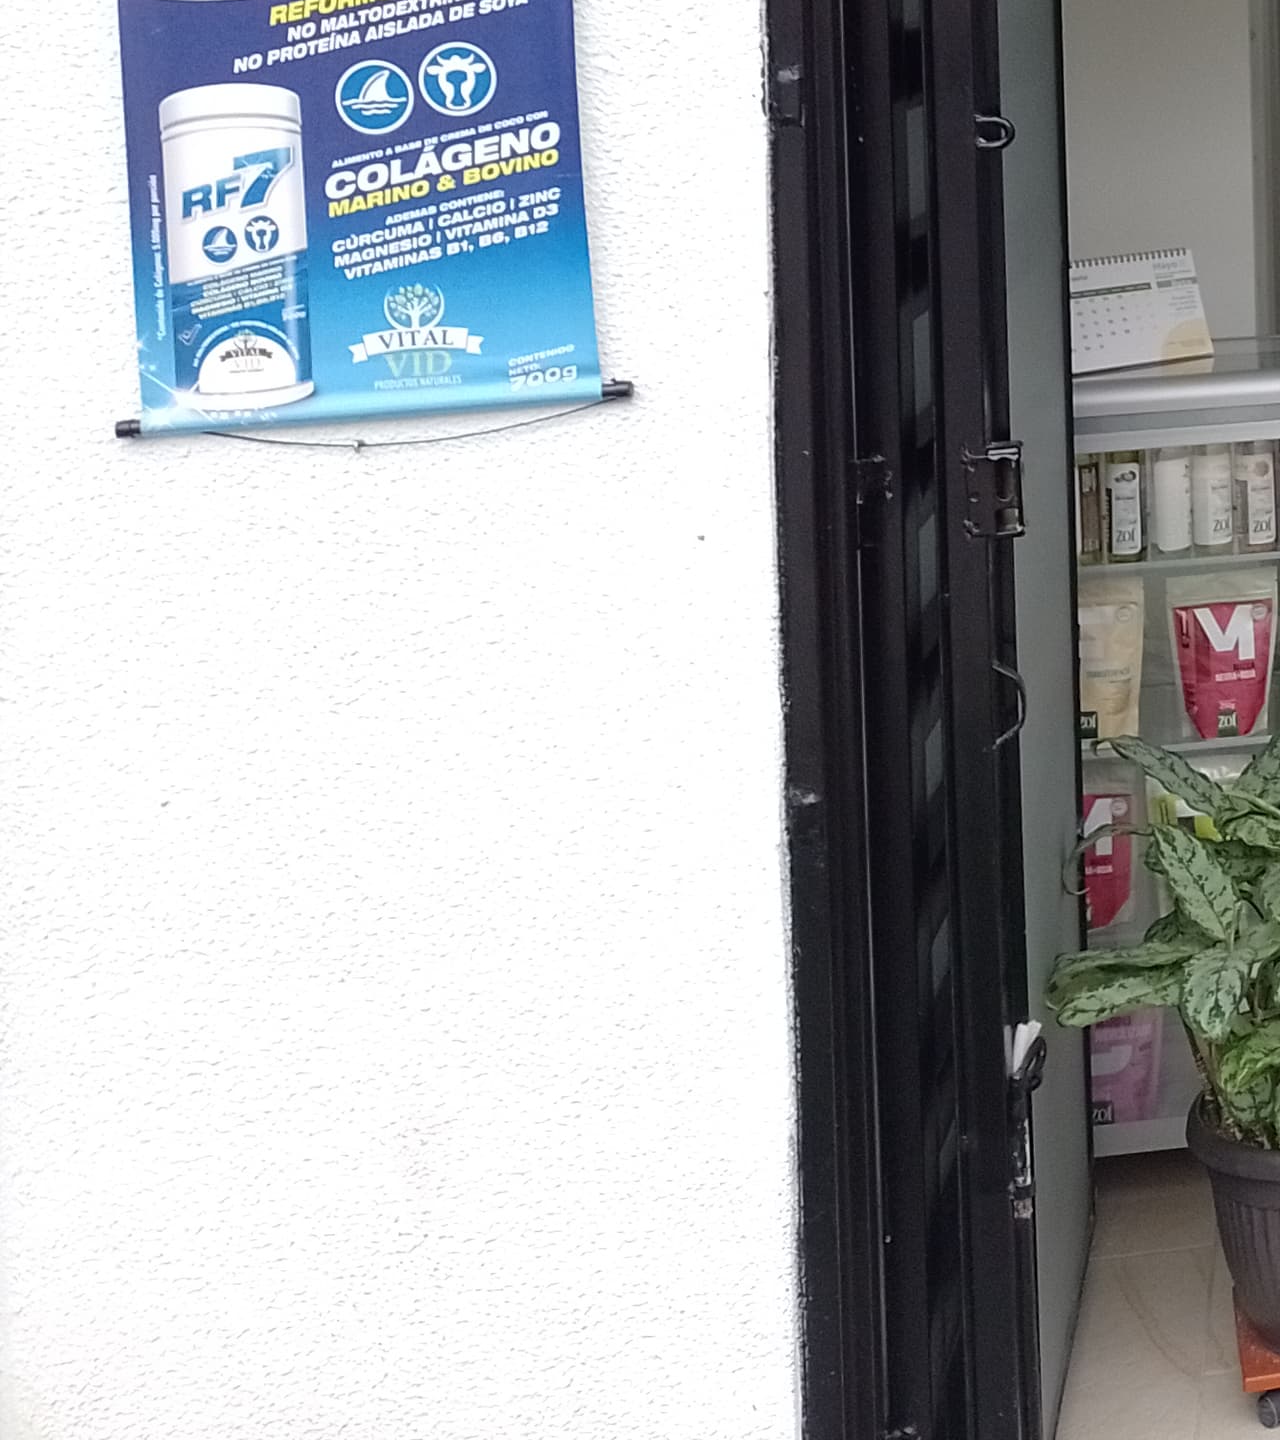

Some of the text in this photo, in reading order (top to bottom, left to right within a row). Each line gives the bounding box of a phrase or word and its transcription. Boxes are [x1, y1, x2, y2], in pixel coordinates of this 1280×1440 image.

[233, 53, 262, 74] NO
[267, 32, 360, 66] PROTEÍNA
[365, 7, 444, 42] AISLADA
[449, 1, 475, 22] DE
[287, 22, 316, 42] NO
[182, 146, 292, 219] RF7
[324, 121, 560, 200] COLÁGENO
[328, 148, 559, 218] MARINO & BOVINO
[334, 203, 559, 269] MAGNESIO VITAMINA D3
[437, 199, 506, 227] CALCIO
[518, 187, 561, 208] ZINC
[344, 246, 442, 280] VITAMINAS
[514, 220, 549, 239] B12
[378, 330, 454, 350] VITAL
[383, 350, 453, 377] VID
